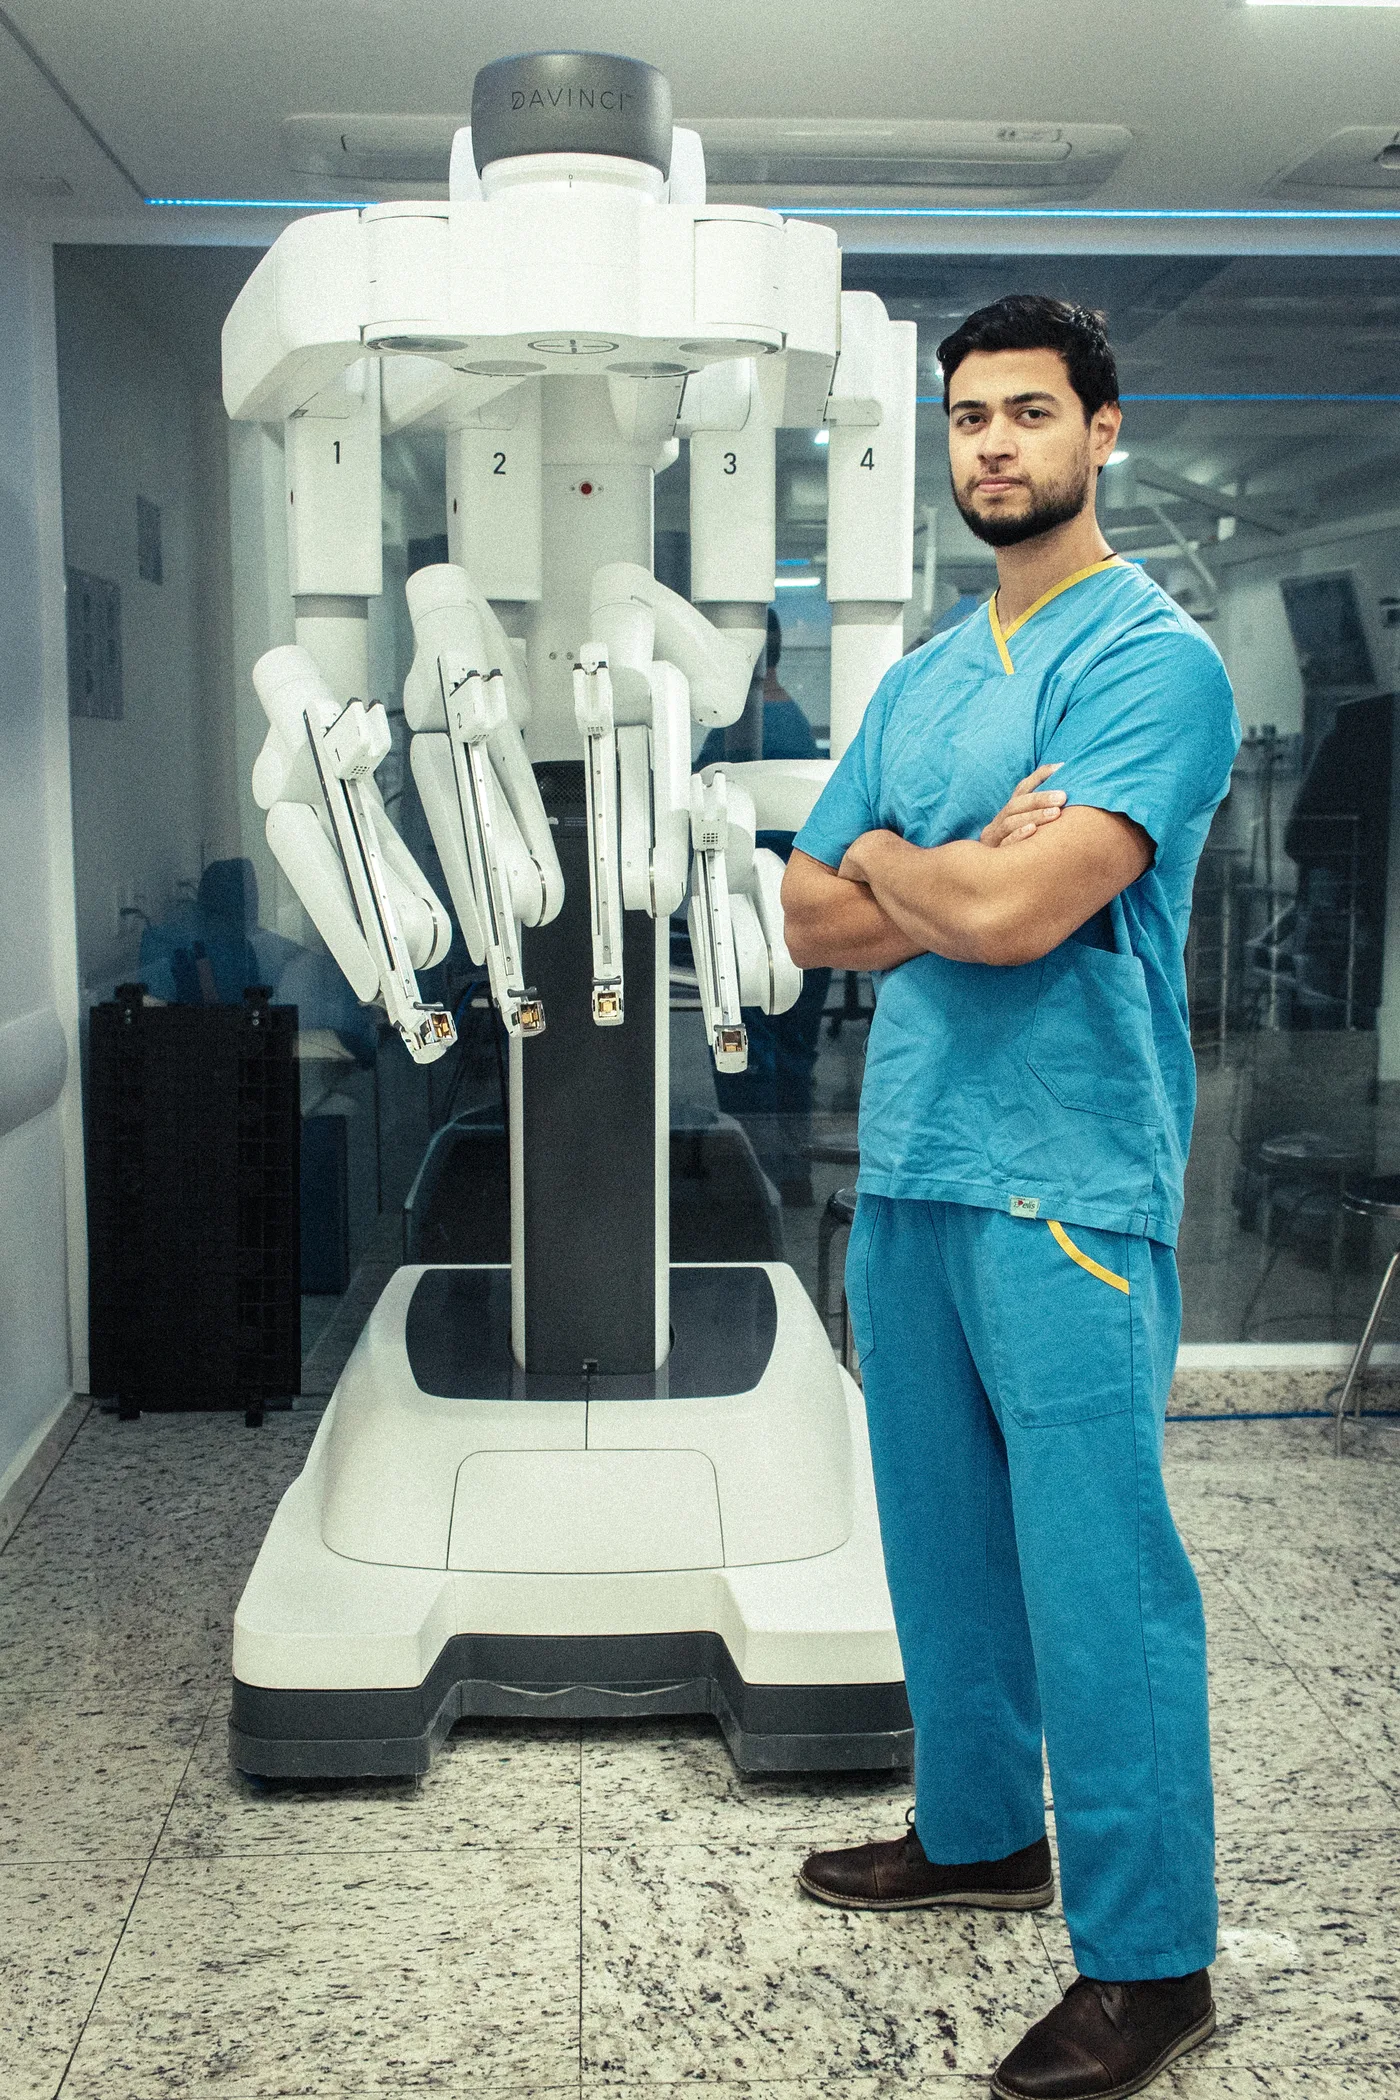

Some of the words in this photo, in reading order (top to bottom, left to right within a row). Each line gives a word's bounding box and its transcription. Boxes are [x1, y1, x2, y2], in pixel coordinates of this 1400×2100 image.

[511, 88, 623, 111] DAVINCI
[333, 441, 341, 464] 1
[493, 452, 507, 475] 2
[723, 452, 737, 475] 3
[860, 447, 875, 470] 4
